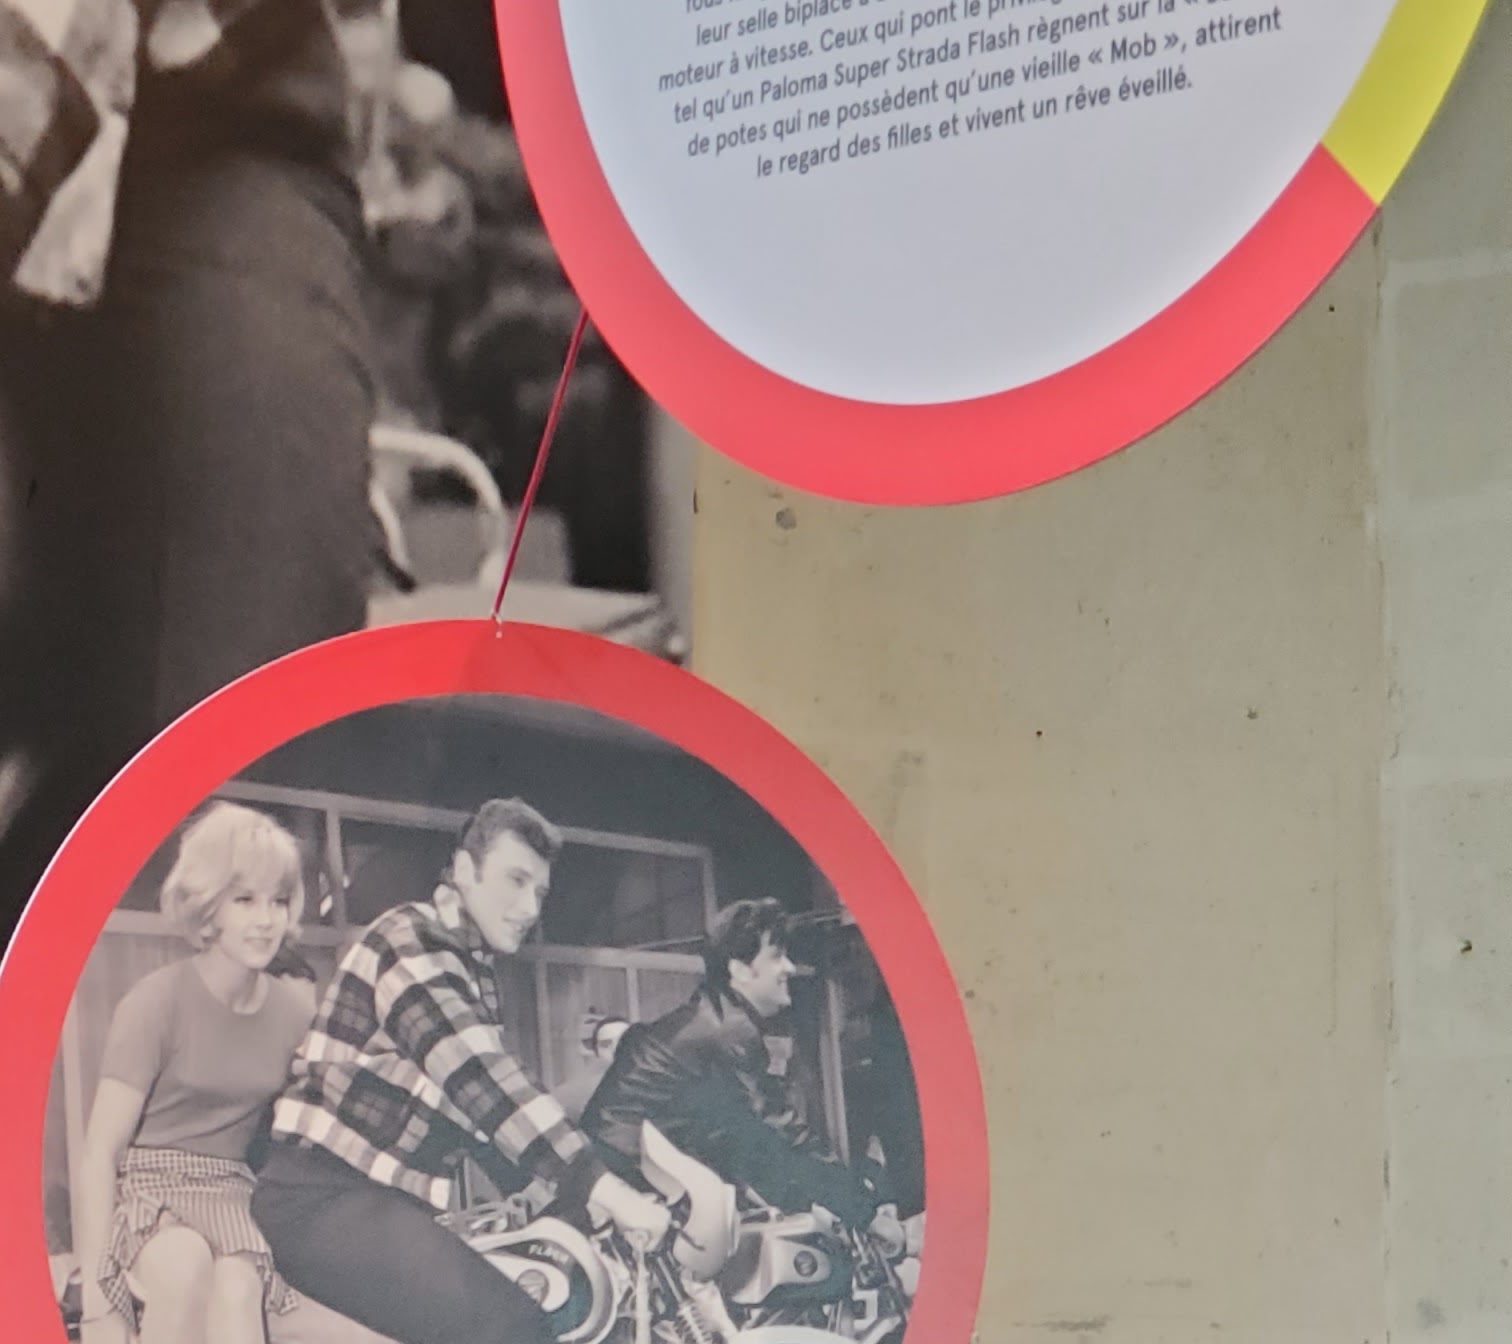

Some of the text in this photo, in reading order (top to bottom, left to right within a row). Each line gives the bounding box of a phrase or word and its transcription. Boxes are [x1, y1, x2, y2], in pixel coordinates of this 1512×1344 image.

[658, 60, 725, 92] moteur
[729, 51, 740, 75] à
[744, 40, 814, 71] vitesse.
[819, 25, 869, 53] Ceux
[873, 10, 905, 45] qui
[910, 0, 958, 38] pont
[673, 97, 697, 124] tel
[760, 71, 828, 105] Paloma
[833, 57, 891, 89] Super
[896, 37, 961, 73] Strada
[967, 22, 1021, 57] Flash
[1027, 2, 1110, 45] règnent
[687, 132, 711, 157] de
[715, 122, 768, 157] potes
[772, 108, 802, 143] qui
[807, 108, 831, 130] ne
[836, 79, 939, 130] possèdent
[1021, 49, 1081, 83] vieille
[1110, 31, 1157, 65] Mob
[1195, 5, 1282, 47] attirent
[696, 22, 732, 46] leur
[737, 7, 779, 37] selle
[756, 63, 1193, 178] le regard des filles et vivent un rêve éveillé.
